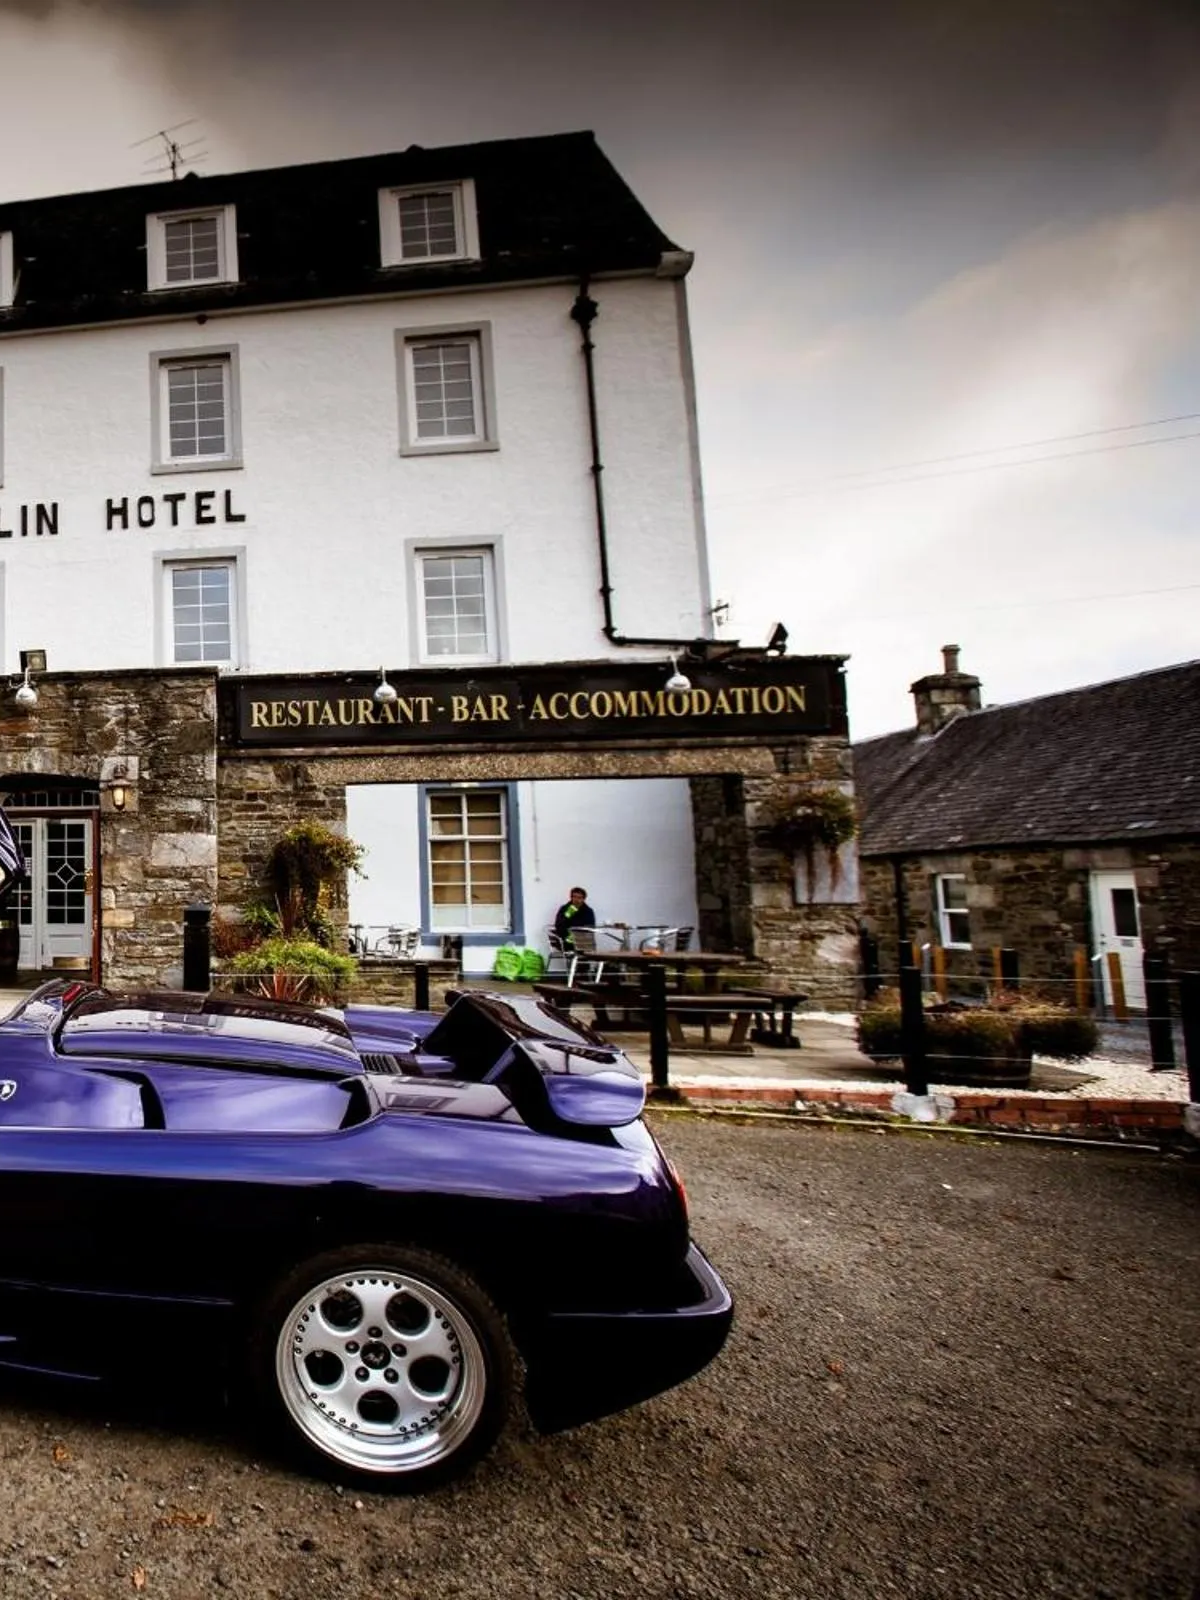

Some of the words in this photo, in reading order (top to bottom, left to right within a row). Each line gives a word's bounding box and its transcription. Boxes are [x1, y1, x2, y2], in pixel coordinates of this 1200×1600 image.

[106, 489, 246, 530] HOTEL
[251, 696, 433, 728] RESTAURANT
[451, 694, 510, 722] BAR
[529, 685, 806, 720] ACCOMMODATION
